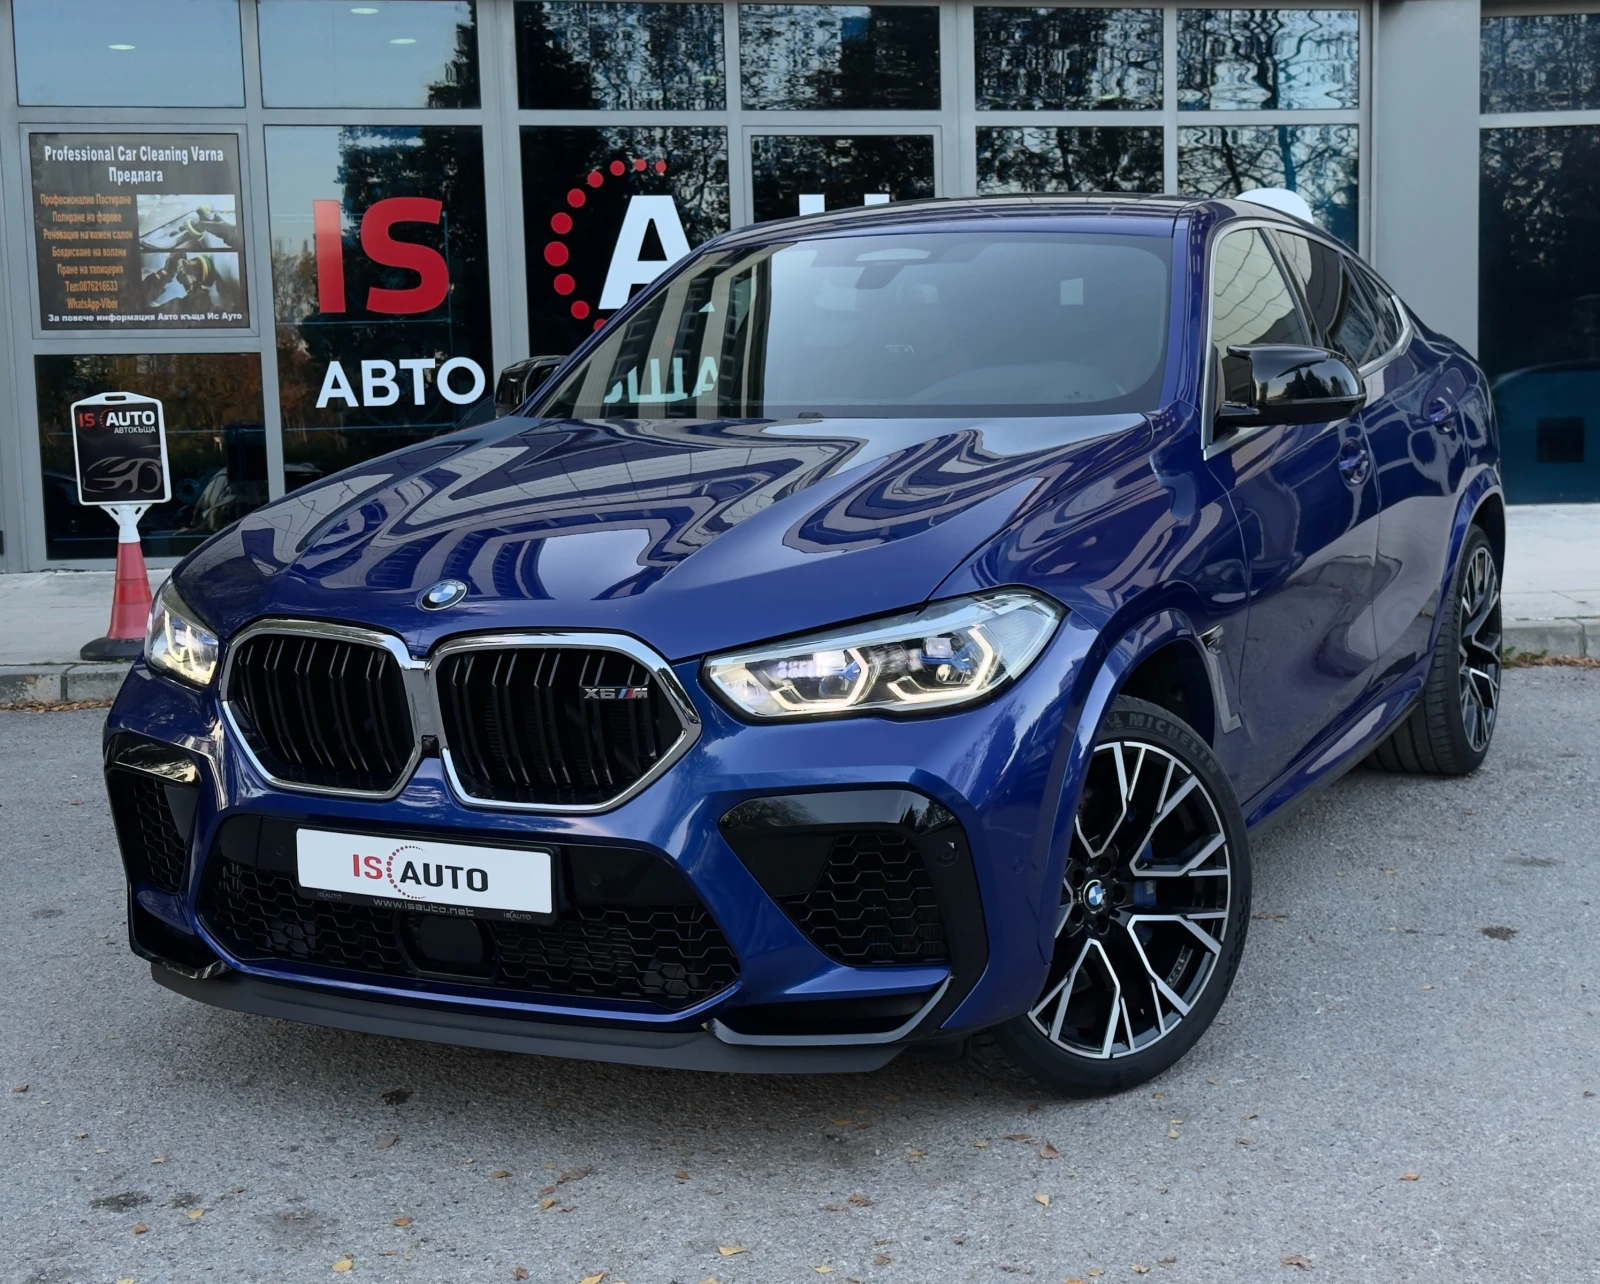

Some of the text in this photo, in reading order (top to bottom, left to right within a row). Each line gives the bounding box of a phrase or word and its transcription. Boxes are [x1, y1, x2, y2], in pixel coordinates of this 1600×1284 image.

[44, 145, 224, 165] Professional Car Cleaning Varna
[108, 166, 164, 185] Предлага
[52, 211, 122, 224] Полиране на фарове
[43, 228, 79, 240] Реновация
[80, 231, 89, 239] на
[112, 231, 133, 239] салон
[92, 248, 101, 257] на
[313, 196, 449, 315] IS
[57, 263, 78, 277] Пране
[79, 266, 88, 274] на
[48, 312, 243, 323] За повече информация Авто къща Ис Ауто
[315, 356, 486, 409] АВТО
[78, 410, 155, 428] IS AUTO
[114, 426, 157, 434] АВТОКЪЩА
[1128, 712, 1218, 774] MICHELIN
[352, 853, 489, 893] IS AUTO
[373, 898, 475, 917] www.isauto.net
